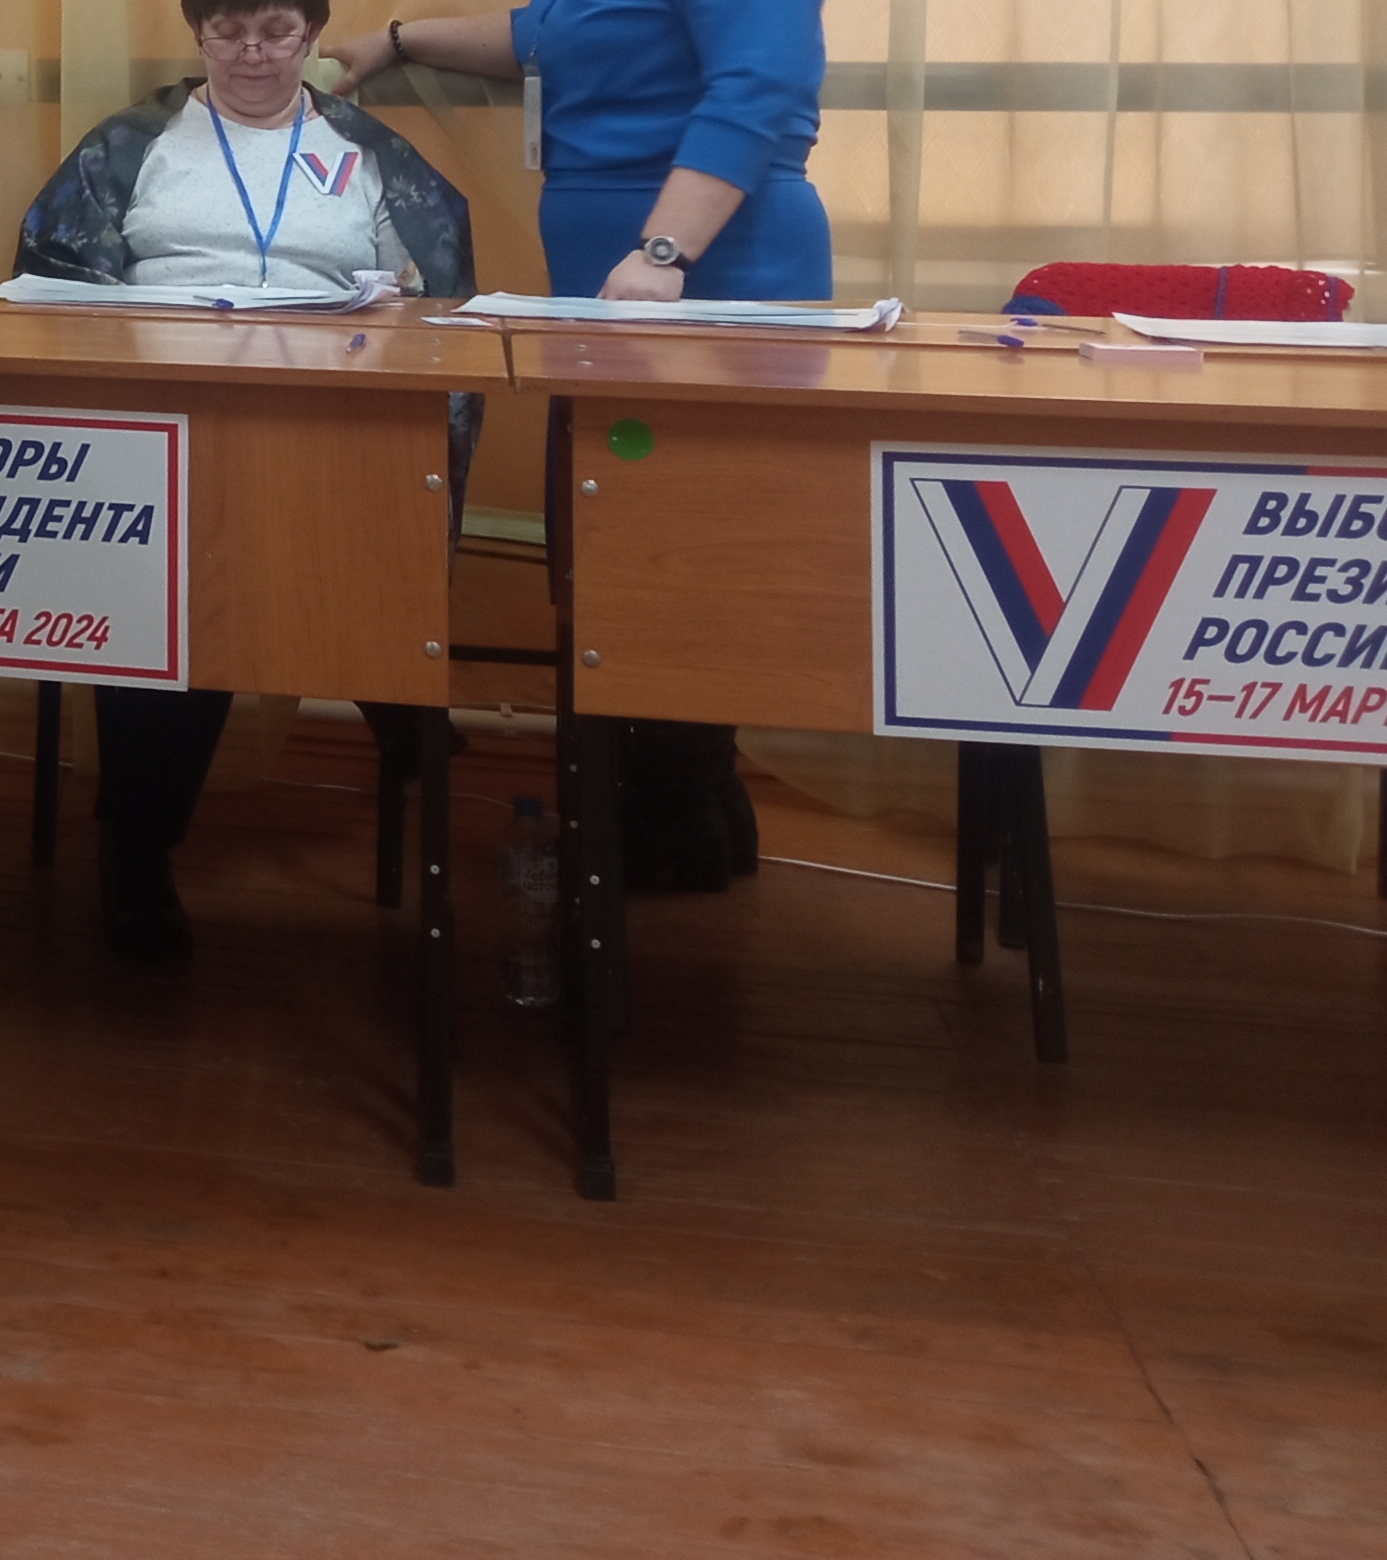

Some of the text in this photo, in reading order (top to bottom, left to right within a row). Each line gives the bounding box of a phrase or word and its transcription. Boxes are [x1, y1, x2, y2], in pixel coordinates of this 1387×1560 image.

[1243, 491, 1387, 541] ВЫБ
[24, 610, 110, 650] 2024
[1182, 617, 1387, 670] РОССИ
[1282, 683, 1387, 726] МАР
